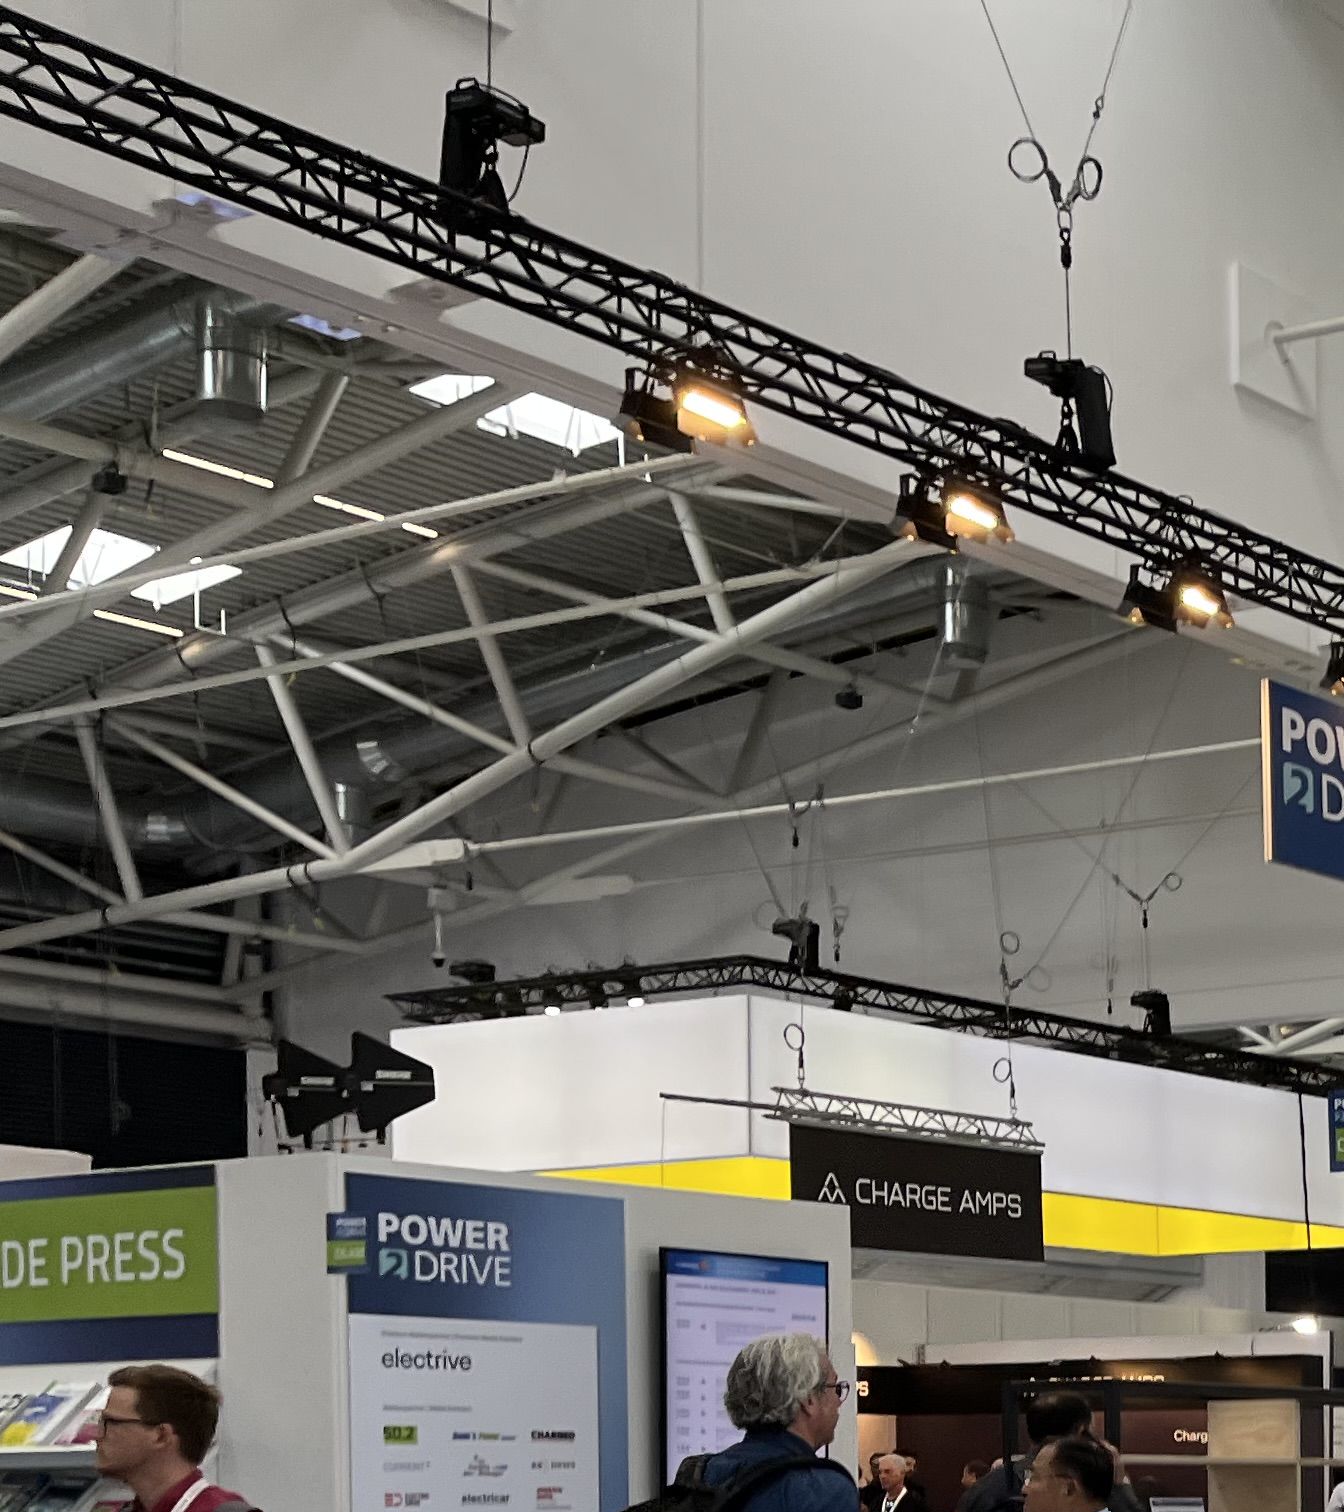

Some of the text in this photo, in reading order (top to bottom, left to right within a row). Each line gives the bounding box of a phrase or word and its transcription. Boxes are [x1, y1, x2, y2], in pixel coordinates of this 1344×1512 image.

[855, 1178, 1022, 1219] CHARGE AMPS
[377, 1212, 510, 1251] POWER
[61, 1228, 186, 1285] PRESS
[414, 1250, 512, 1287] DRIVE
[382, 1347, 472, 1371] electrive
